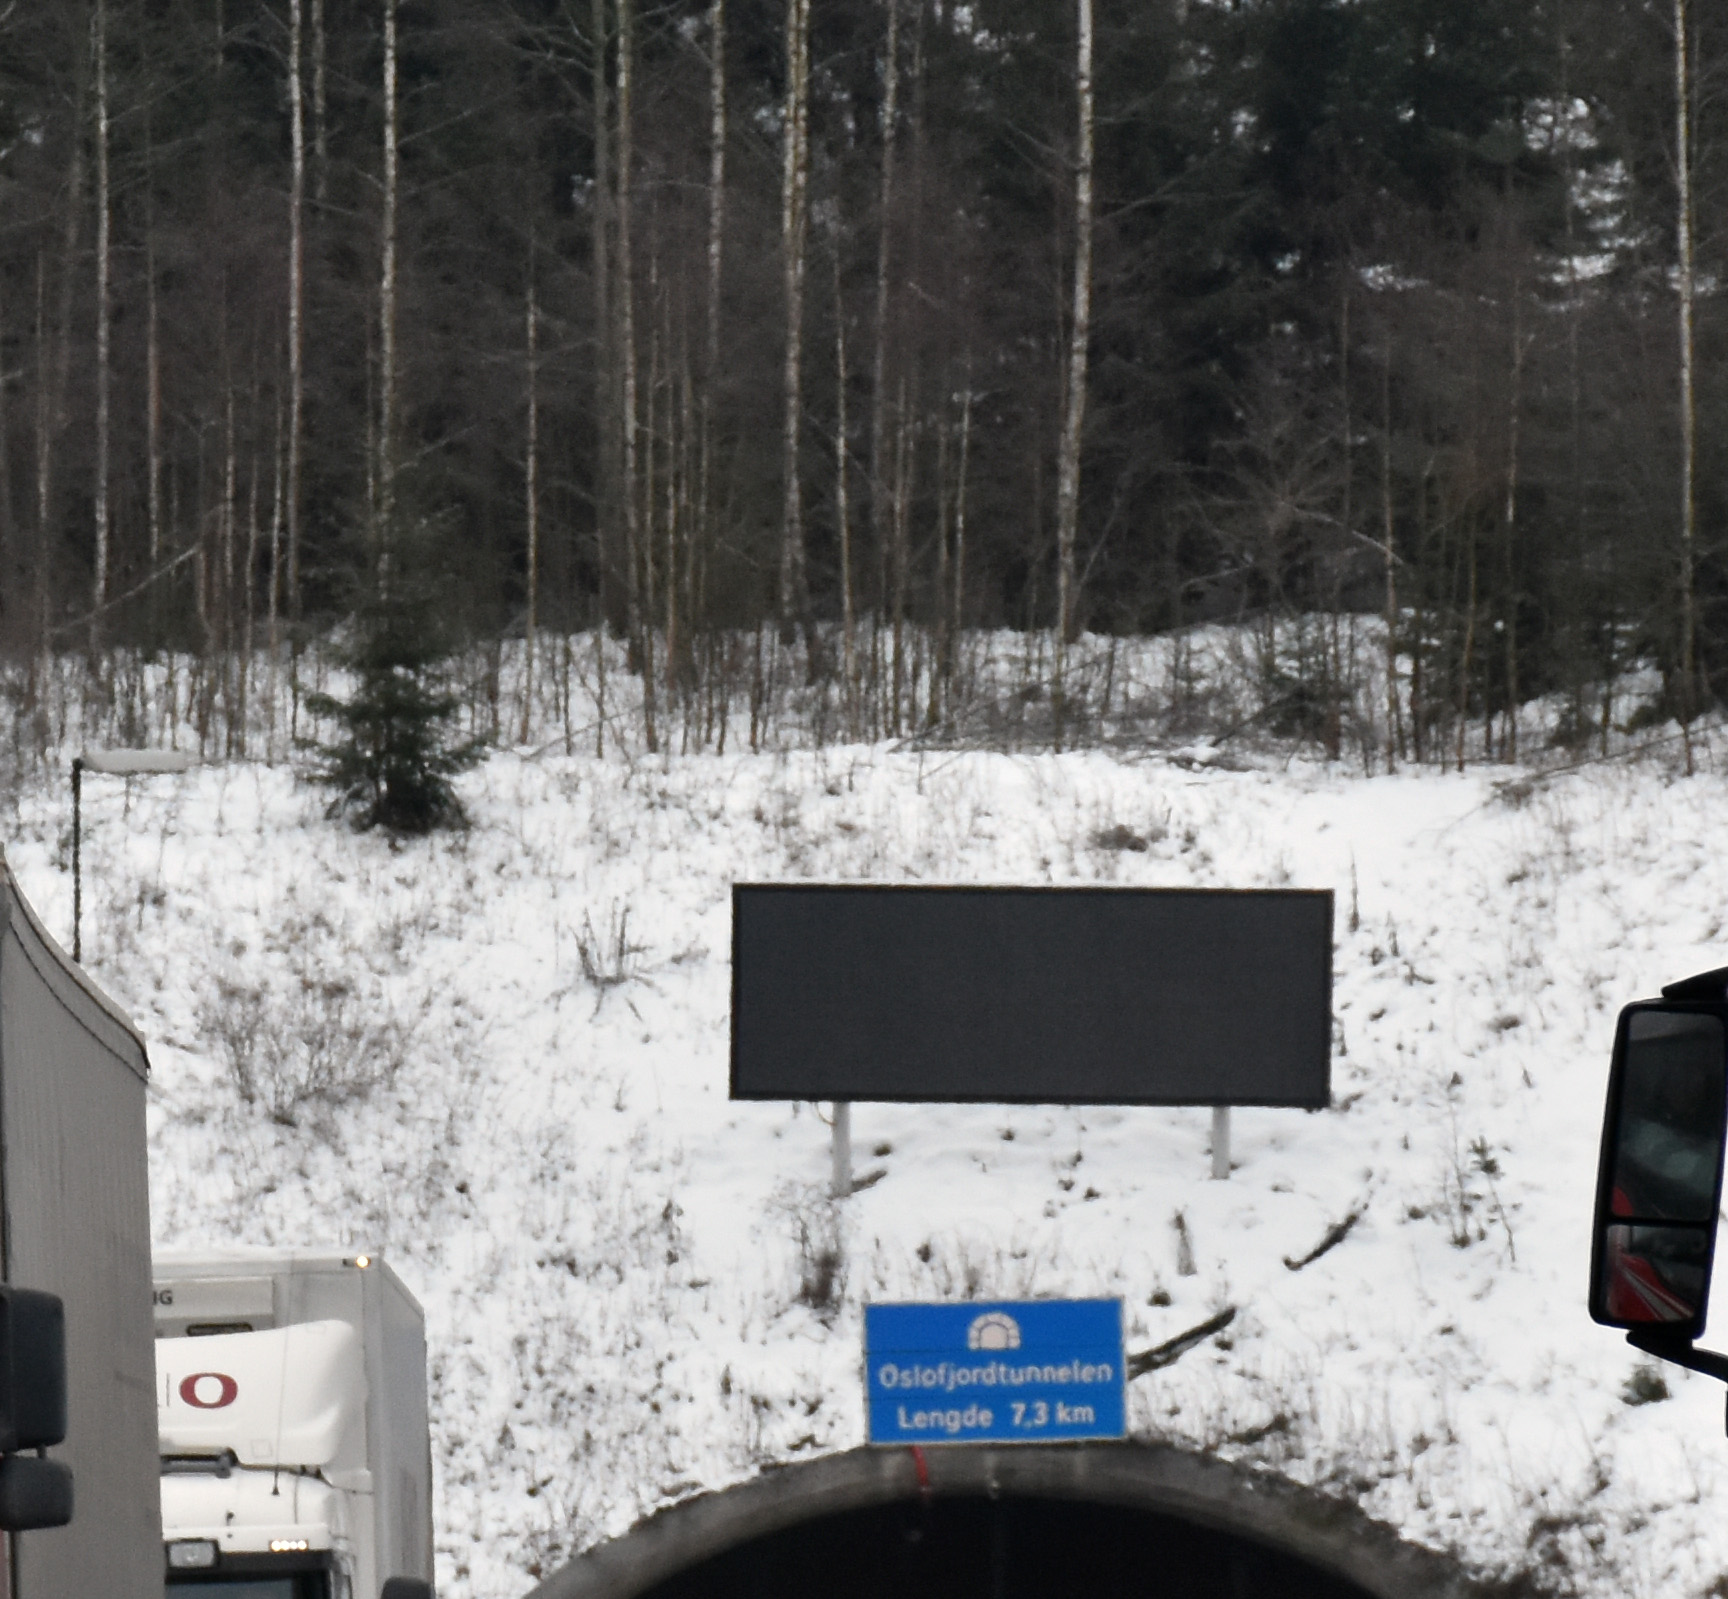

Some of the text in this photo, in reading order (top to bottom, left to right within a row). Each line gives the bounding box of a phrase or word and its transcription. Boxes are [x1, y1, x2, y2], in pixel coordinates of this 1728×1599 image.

[879, 1360, 1114, 1392] Oslofjordtunnelen
[897, 1402, 1096, 1434] Lengde 7,3 km
